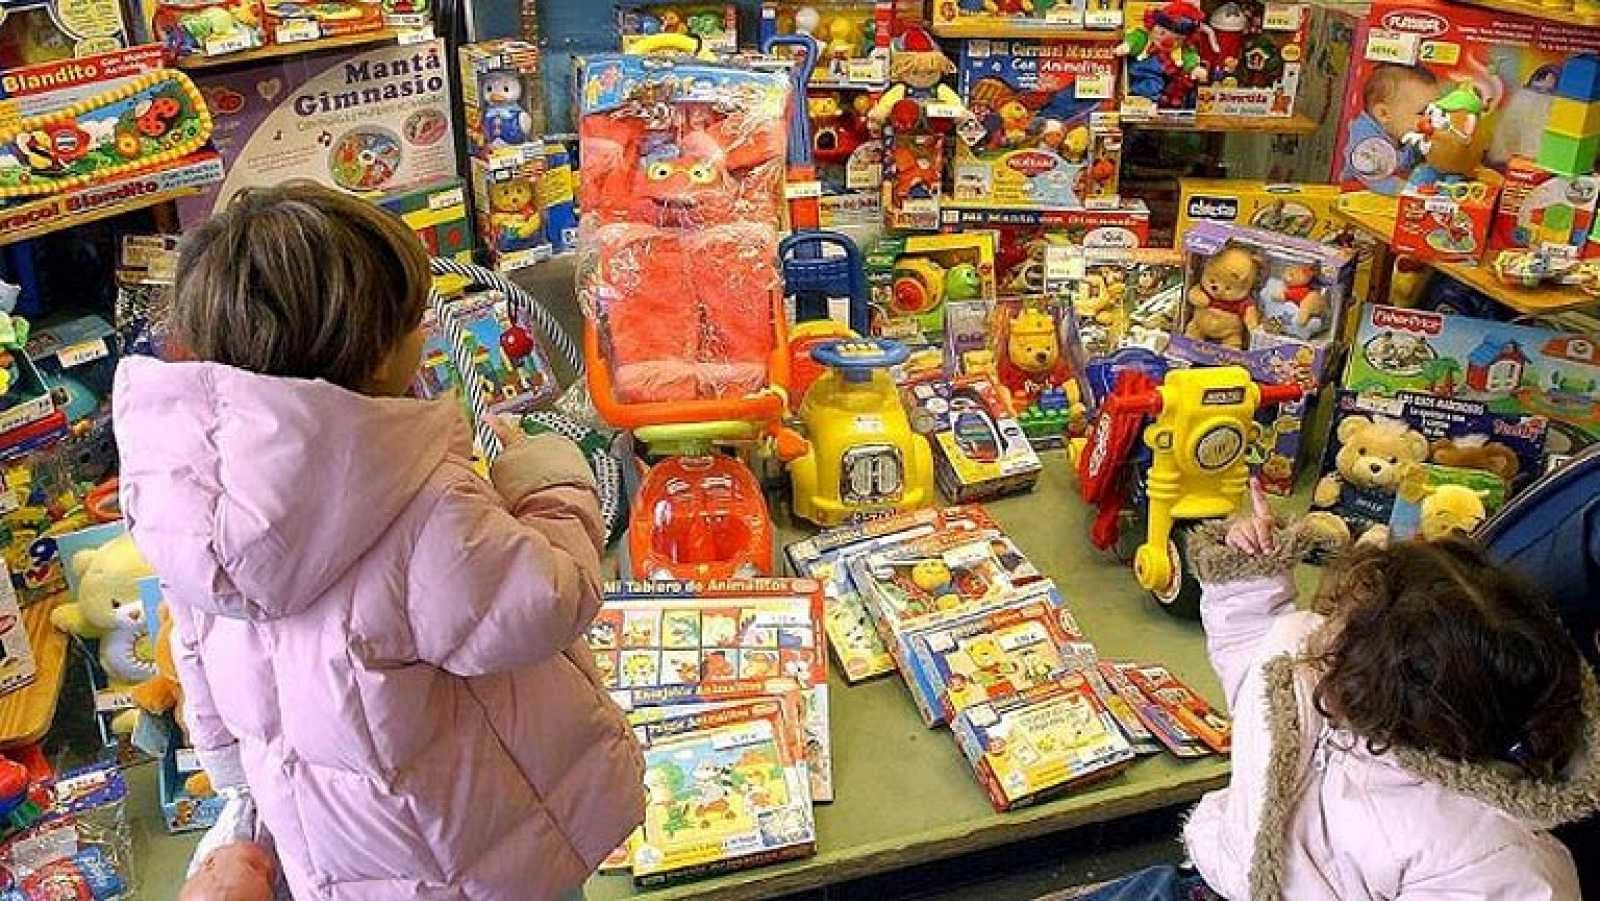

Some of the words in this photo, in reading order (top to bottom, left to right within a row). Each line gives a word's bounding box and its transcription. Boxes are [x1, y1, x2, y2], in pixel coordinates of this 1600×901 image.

[1422, 44, 1434, 58] 2
[345, 52, 440, 85] Manta
[1012, 58, 1037, 72] Con
[2, 63, 97, 93] Blandito
[294, 75, 443, 117] Gimnasio
[625, 581, 681, 593] Tablero
